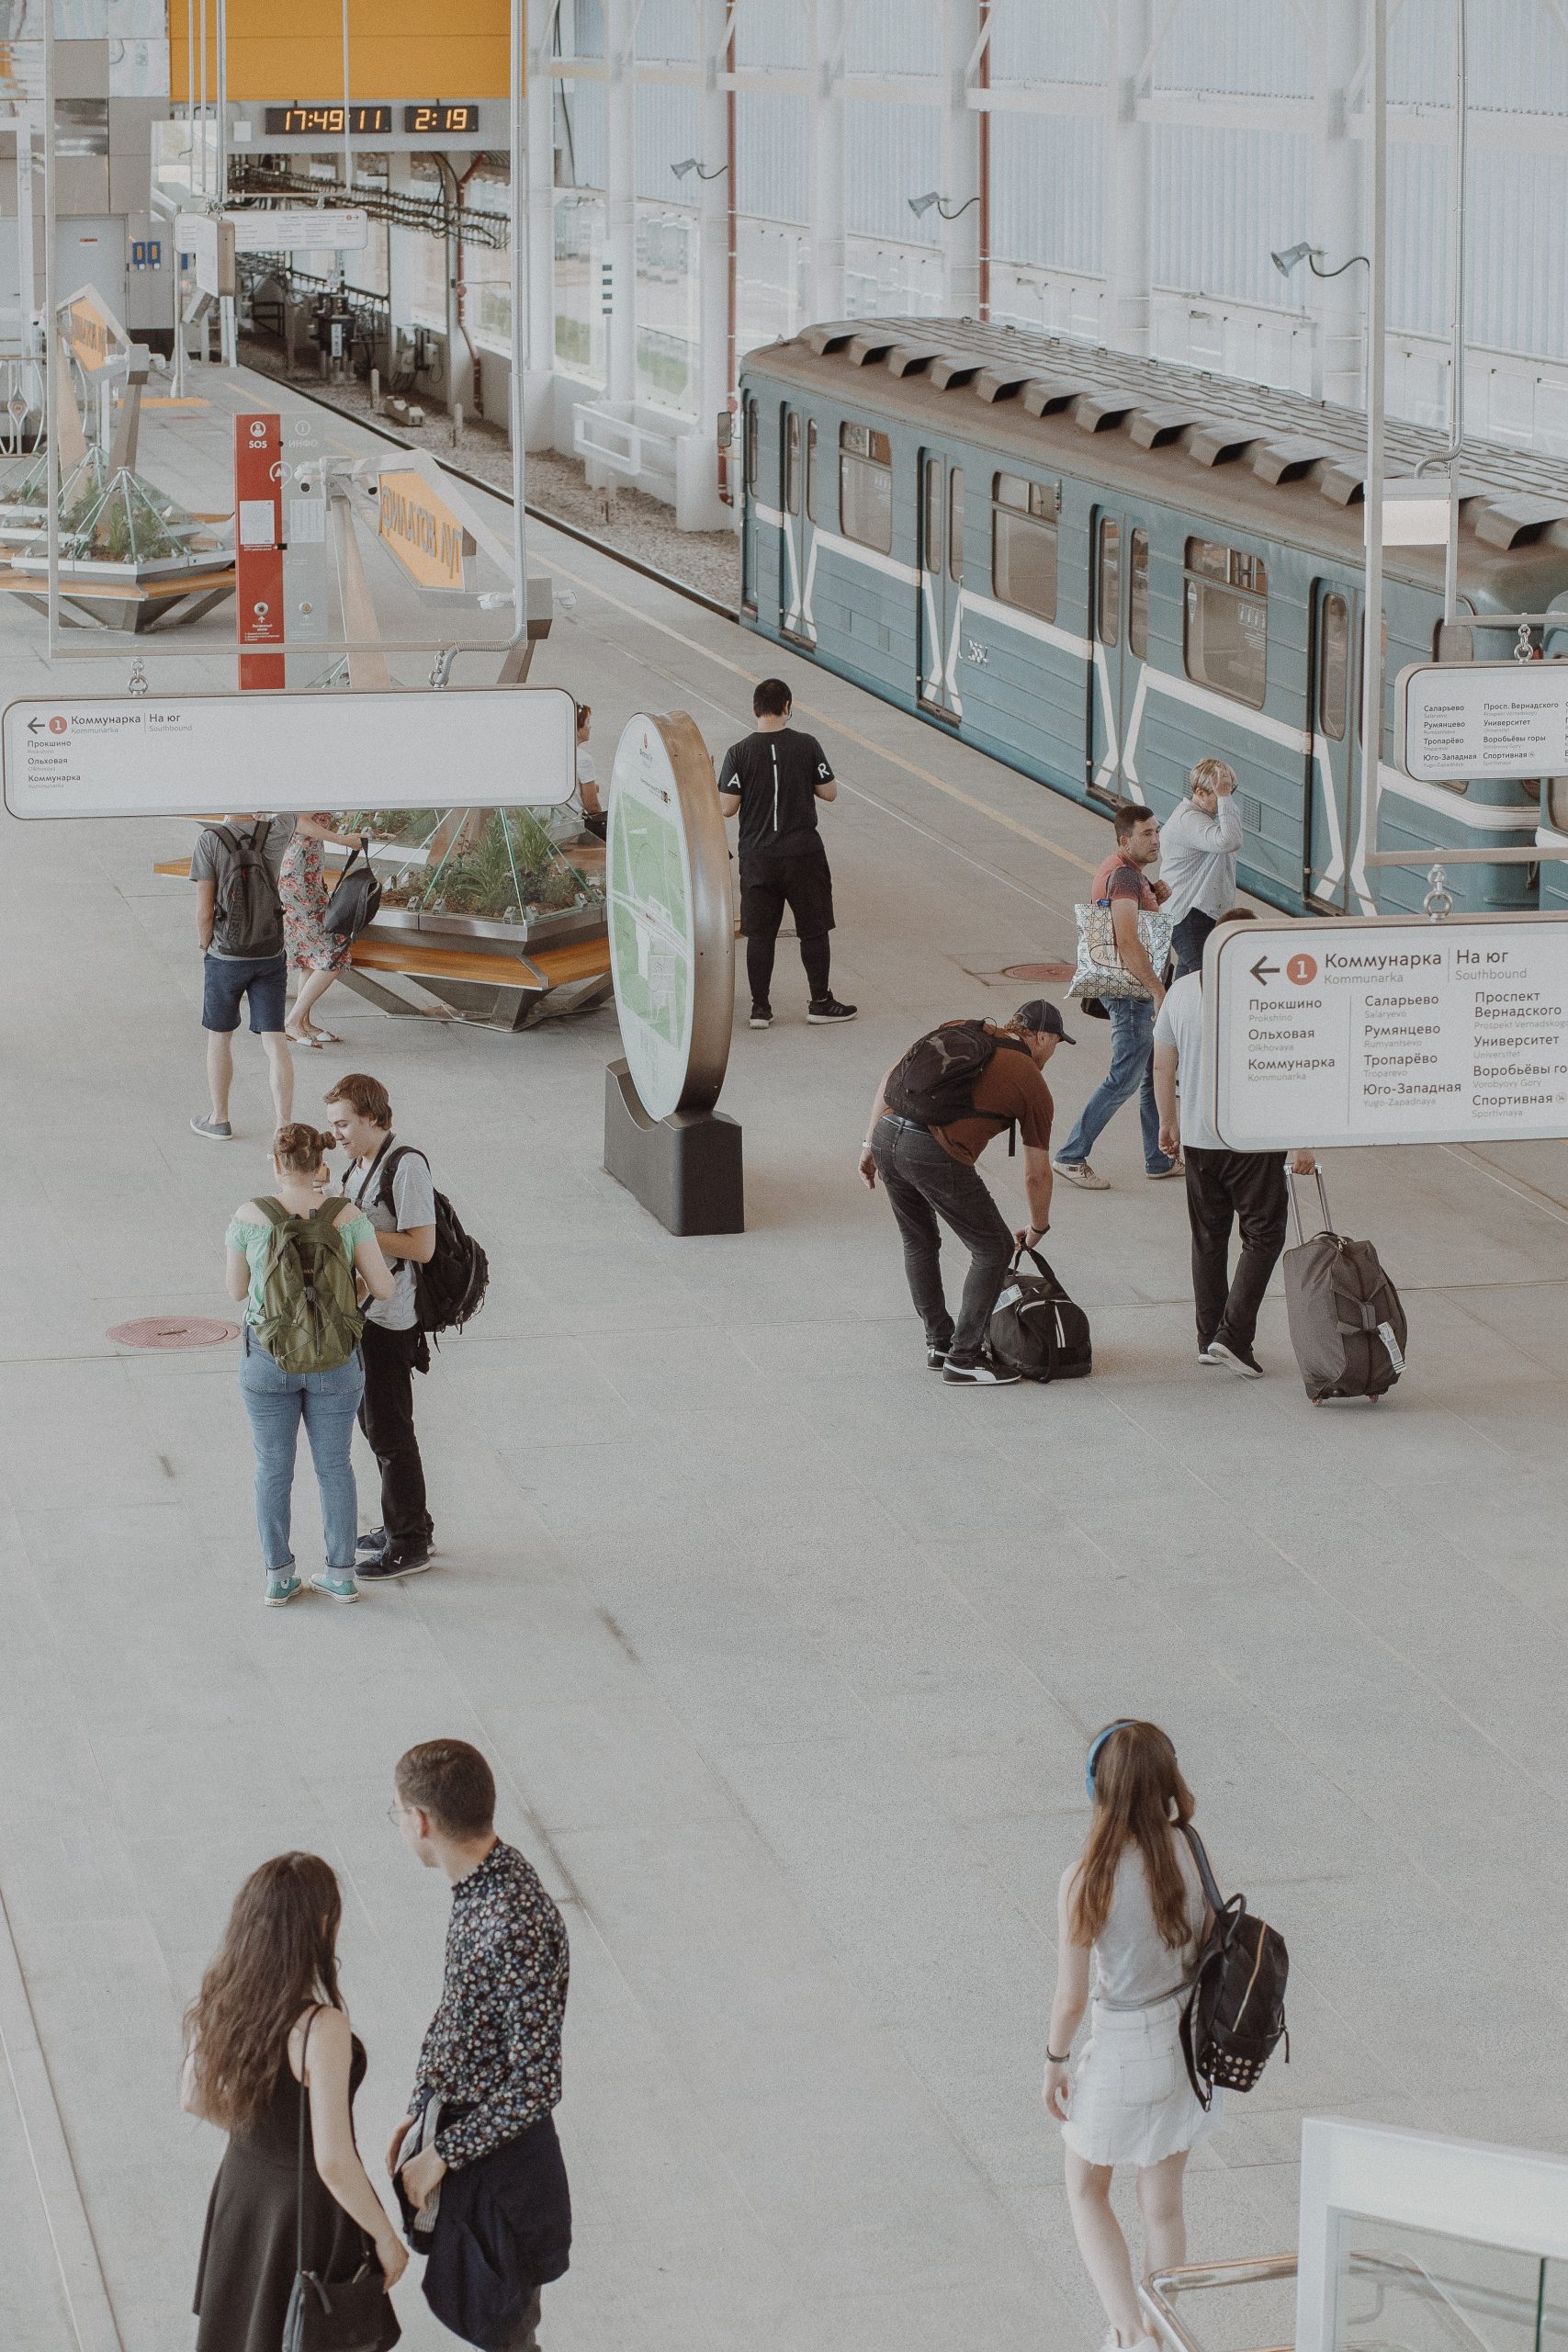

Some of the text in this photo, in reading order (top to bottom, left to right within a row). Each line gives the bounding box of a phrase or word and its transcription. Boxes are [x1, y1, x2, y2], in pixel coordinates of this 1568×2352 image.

[414, 109, 468, 130] 2:19
[248, 440, 267, 448] SOS
[72, 717, 141, 726] Коммунарка
[150, 714, 164, 722] На
[55, 719, 62, 730] 1
[149, 724, 192, 732] Southbound
[1424, 738, 1463, 746] Тропарёво
[818, 763, 830, 779] R
[727, 773, 740, 788] A
[1325, 954, 1441, 970] Коммунарка
[1457, 950, 1508, 964] На юг
[1296, 960, 1307, 978] 1
[1455, 967, 1528, 980] Southbound
[1325, 972, 1404, 985] Kommunarka
[1365, 995, 1438, 1008] Саларьево
[1475, 992, 1540, 1004] Проспект
[1249, 1000, 1322, 1012] Прокшино
[1364, 1010, 1406, 1019] Salaryevo
[1475, 1007, 1562, 1019] Вернадского
[1365, 1025, 1440, 1038] Румянцево
[1474, 1022, 1513, 1030] Prospekt
[1248, 1029, 1314, 1040] Ольховая
[1364, 1038, 1422, 1048] Rumyantsevo
[1474, 1036, 1559, 1047] Университет
[1248, 1059, 1335, 1071] Коммунарка
[1364, 1053, 1438, 1068] Тропарёво
[1248, 1072, 1306, 1081] Kommunarka
[1363, 1069, 1407, 1079] Troparevo
[1473, 1064, 1550, 1078] Воробьёвы
[1364, 1083, 1461, 1095] Юго-Западная
[1520, 1079, 1541, 1088] Gory
[1363, 1097, 1437, 1109] Yugo-Zapadnaya
[1472, 1095, 1552, 1107] Спортивная
[1472, 1109, 1523, 1119] Sportivnaya
